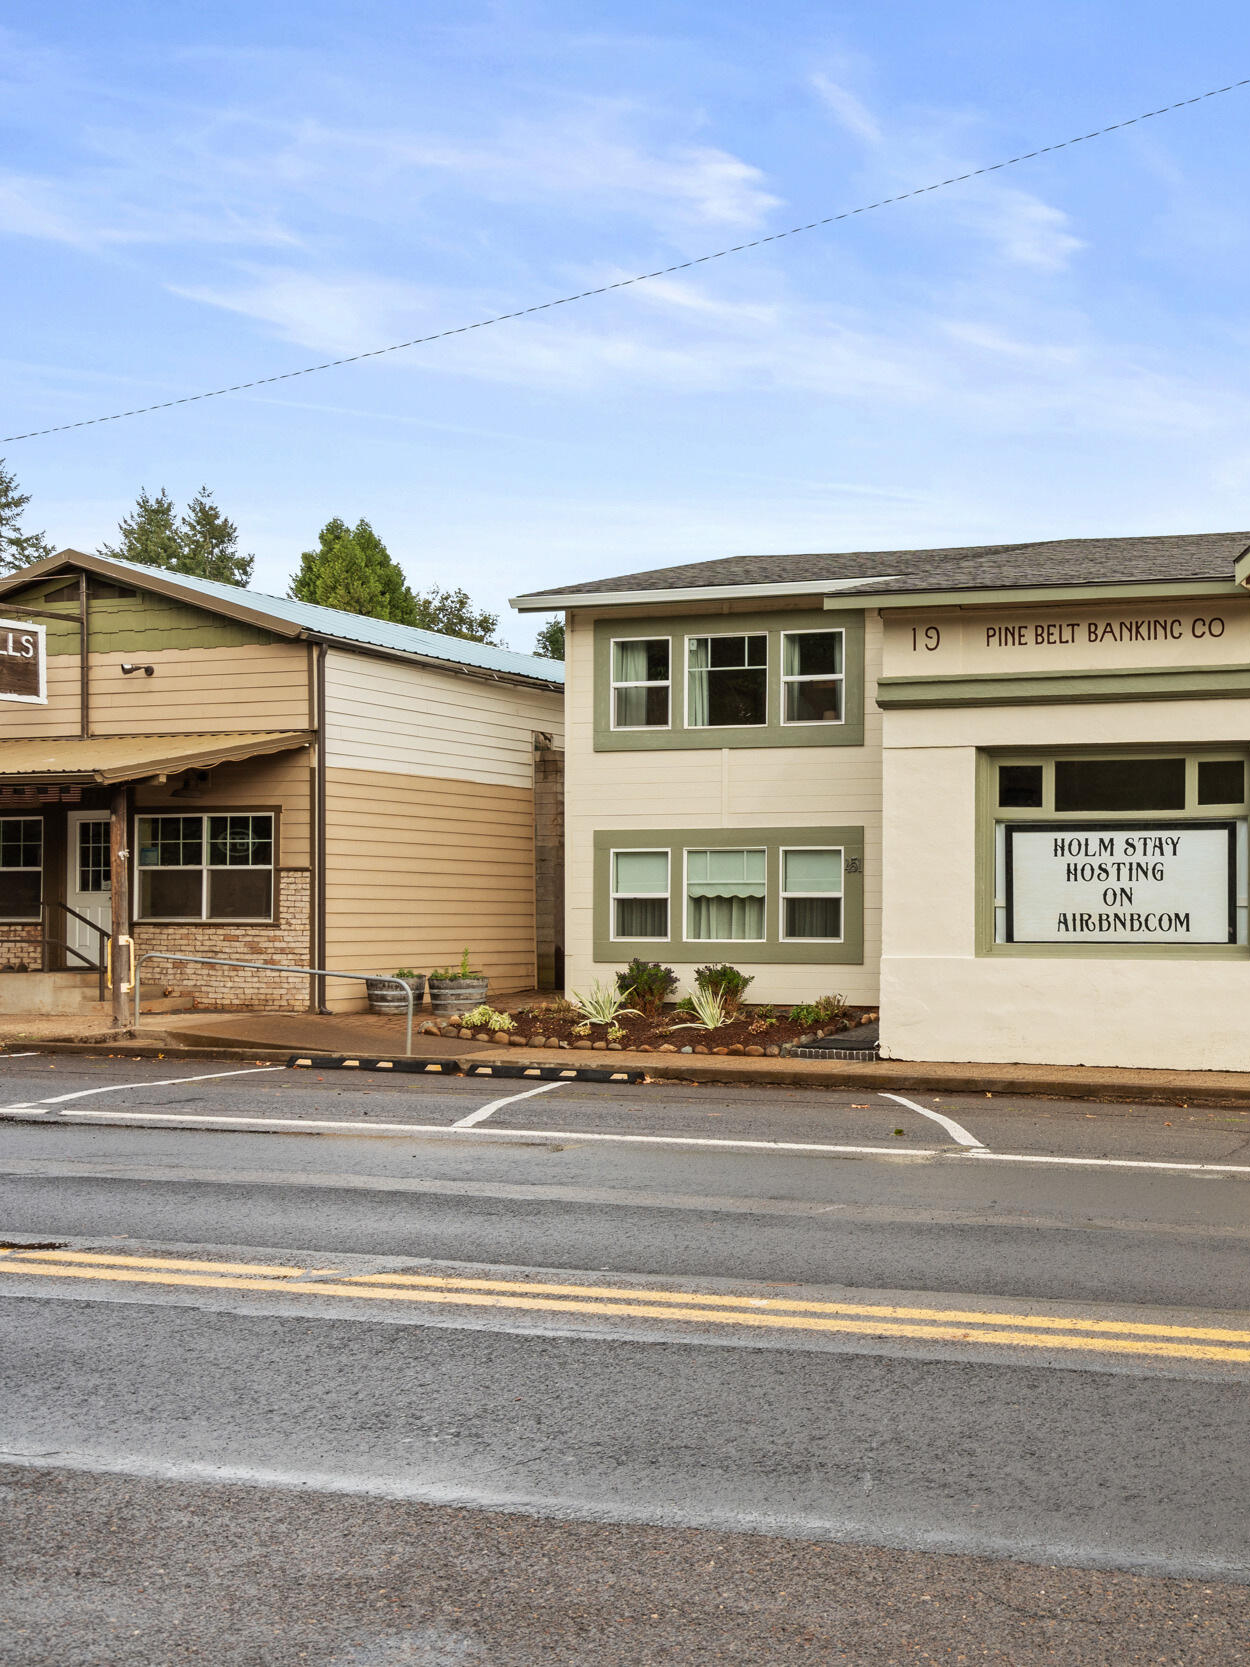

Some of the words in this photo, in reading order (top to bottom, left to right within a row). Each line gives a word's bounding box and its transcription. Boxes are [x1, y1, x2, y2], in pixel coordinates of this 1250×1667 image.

[911, 626, 941, 651] 19
[986, 625, 1028, 647] PINE
[1034, 623, 1080, 645] BELT
[1087, 619, 1183, 643] BANKING
[1191, 617, 1225, 639] CO
[1053, 837, 1115, 857] HOLM
[1123, 836, 1181, 857] STAY
[1066, 861, 1165, 882] HOSTING
[1102, 887, 1133, 907] ON
[1057, 912, 1191, 933] AIRBNB.COM
